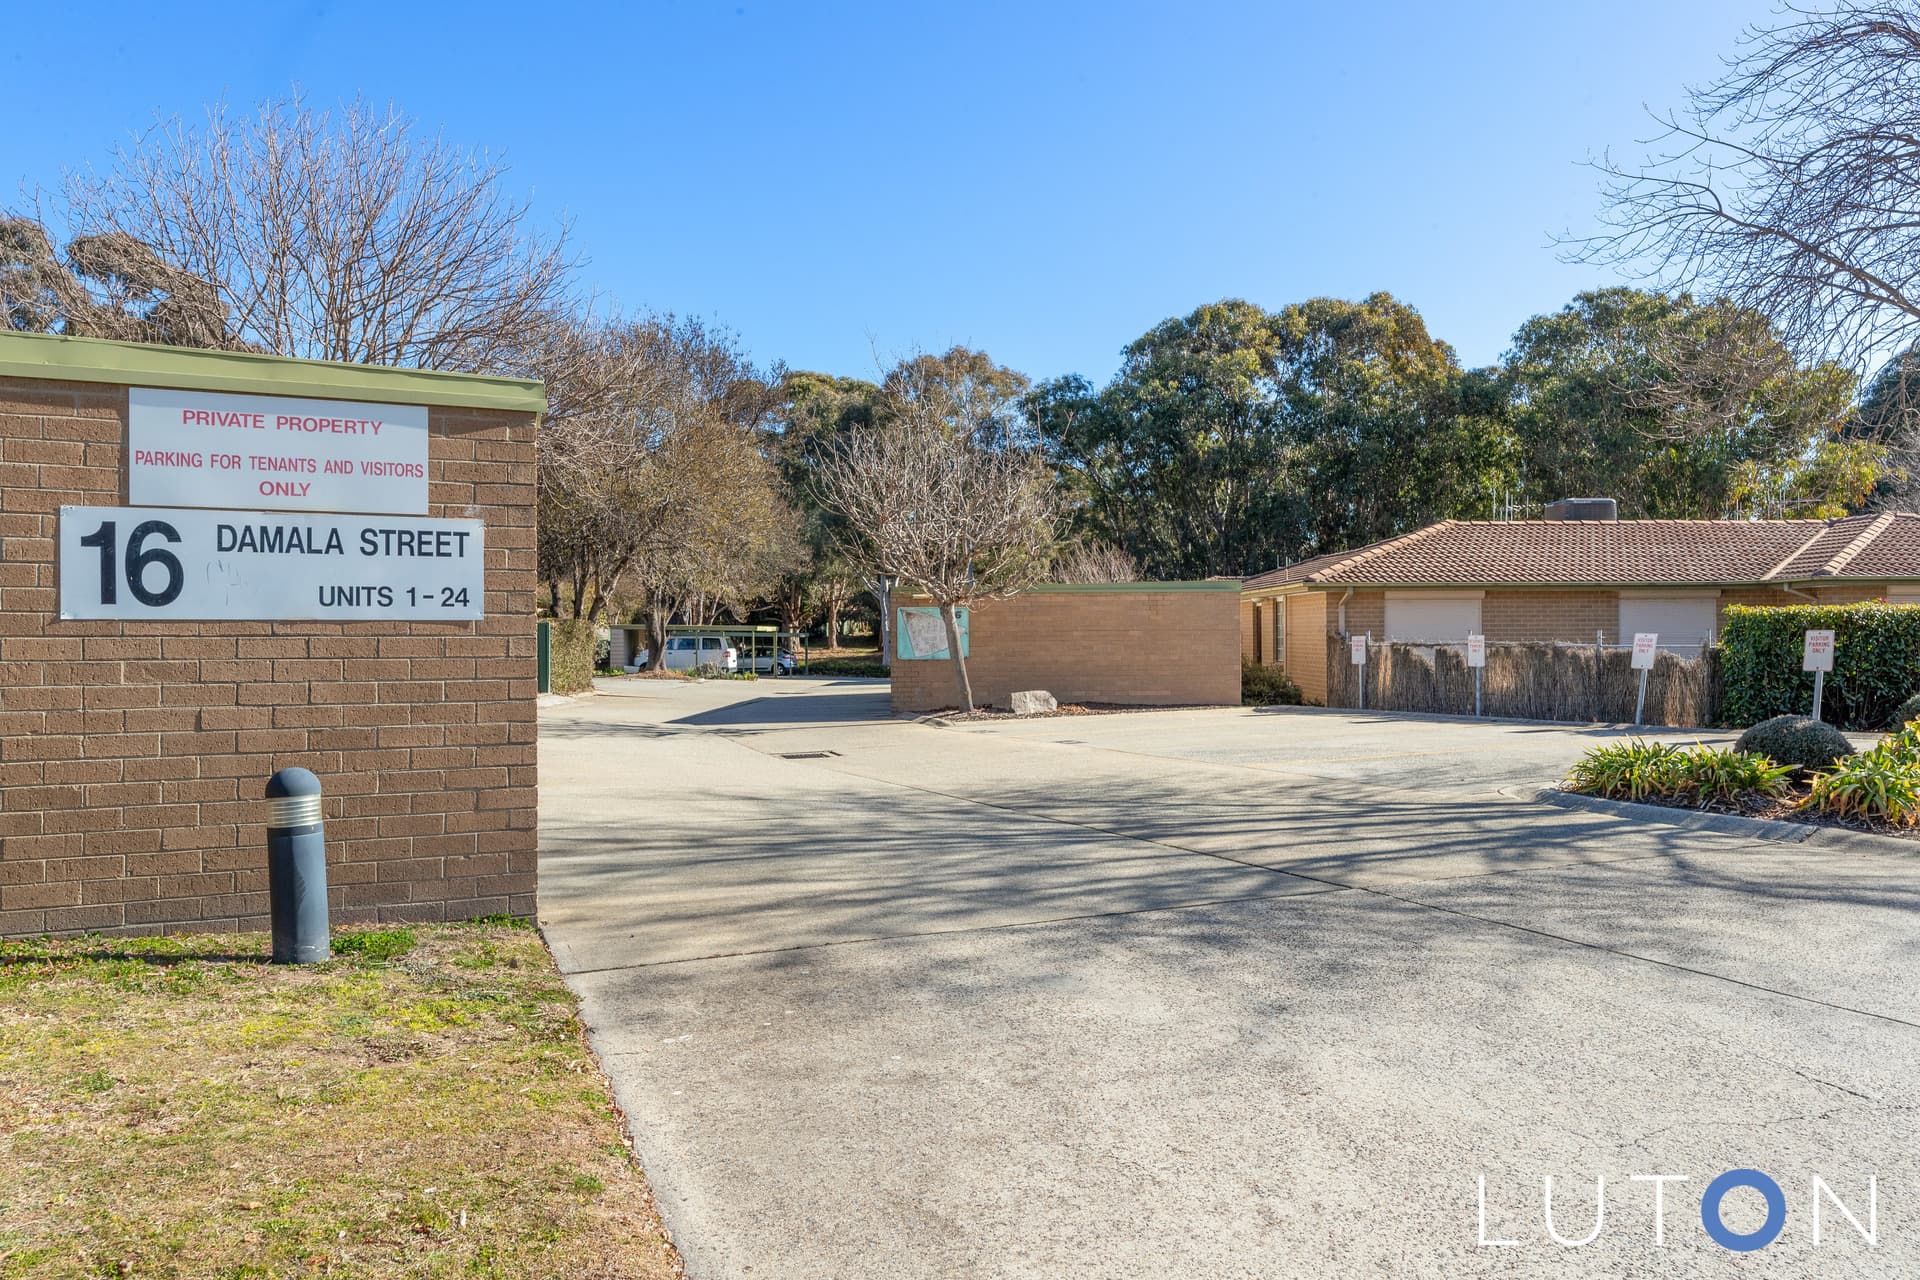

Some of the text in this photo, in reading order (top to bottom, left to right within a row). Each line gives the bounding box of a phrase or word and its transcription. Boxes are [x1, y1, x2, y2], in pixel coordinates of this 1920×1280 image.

[182, 409, 383, 436] PRIVATE PROPERTY
[134, 450, 424, 478] PARKING FOR TENANTS AND VISITORS
[258, 480, 311, 498] ONLY
[80, 520, 470, 607] 16 DAMALA STREET
[318, 585, 394, 608] UNITS
